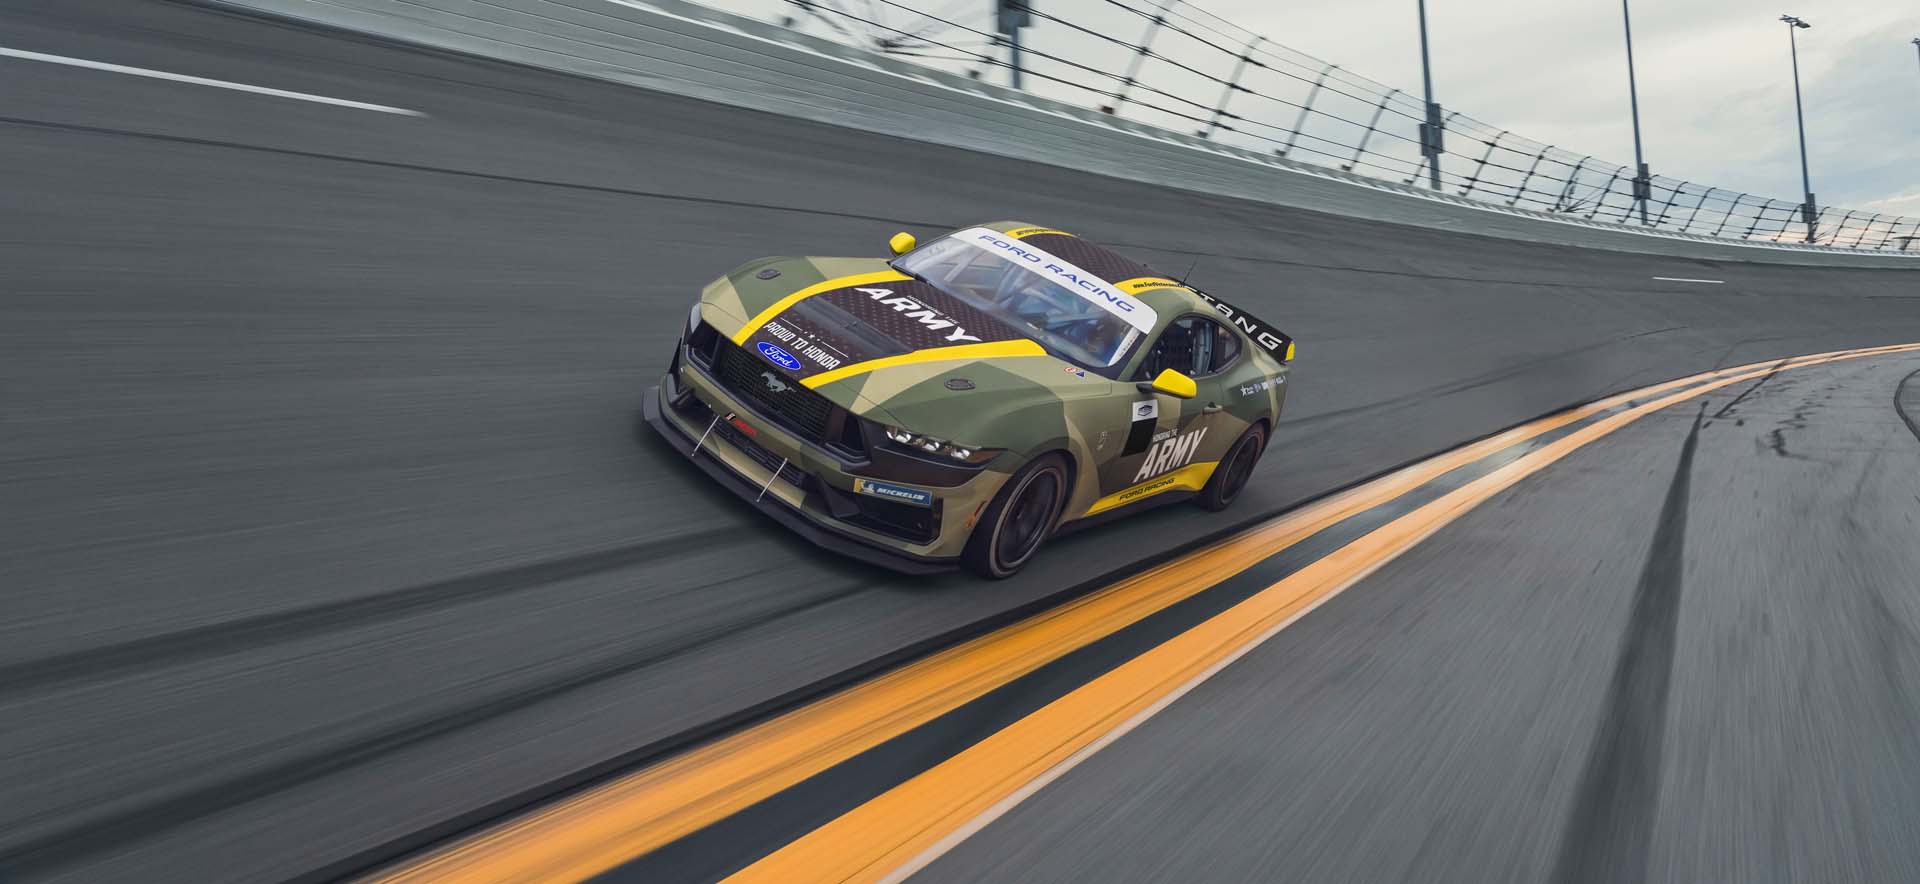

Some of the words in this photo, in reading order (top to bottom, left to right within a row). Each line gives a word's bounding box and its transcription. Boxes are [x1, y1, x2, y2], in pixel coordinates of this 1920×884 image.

[978, 235, 1041, 263] FORD
[1045, 263, 1135, 313] RACING
[854, 287, 983, 342] ARMY
[763, 321, 797, 343] PROUD
[790, 337, 809, 350] TO
[802, 345, 841, 370] HONOR
[764, 346, 794, 367] Ford
[1132, 426, 1209, 484] ARMY
[876, 487, 925, 501] MICHELIN
[1119, 487, 1144, 501] FORD
[1144, 477, 1176, 492] RACING
